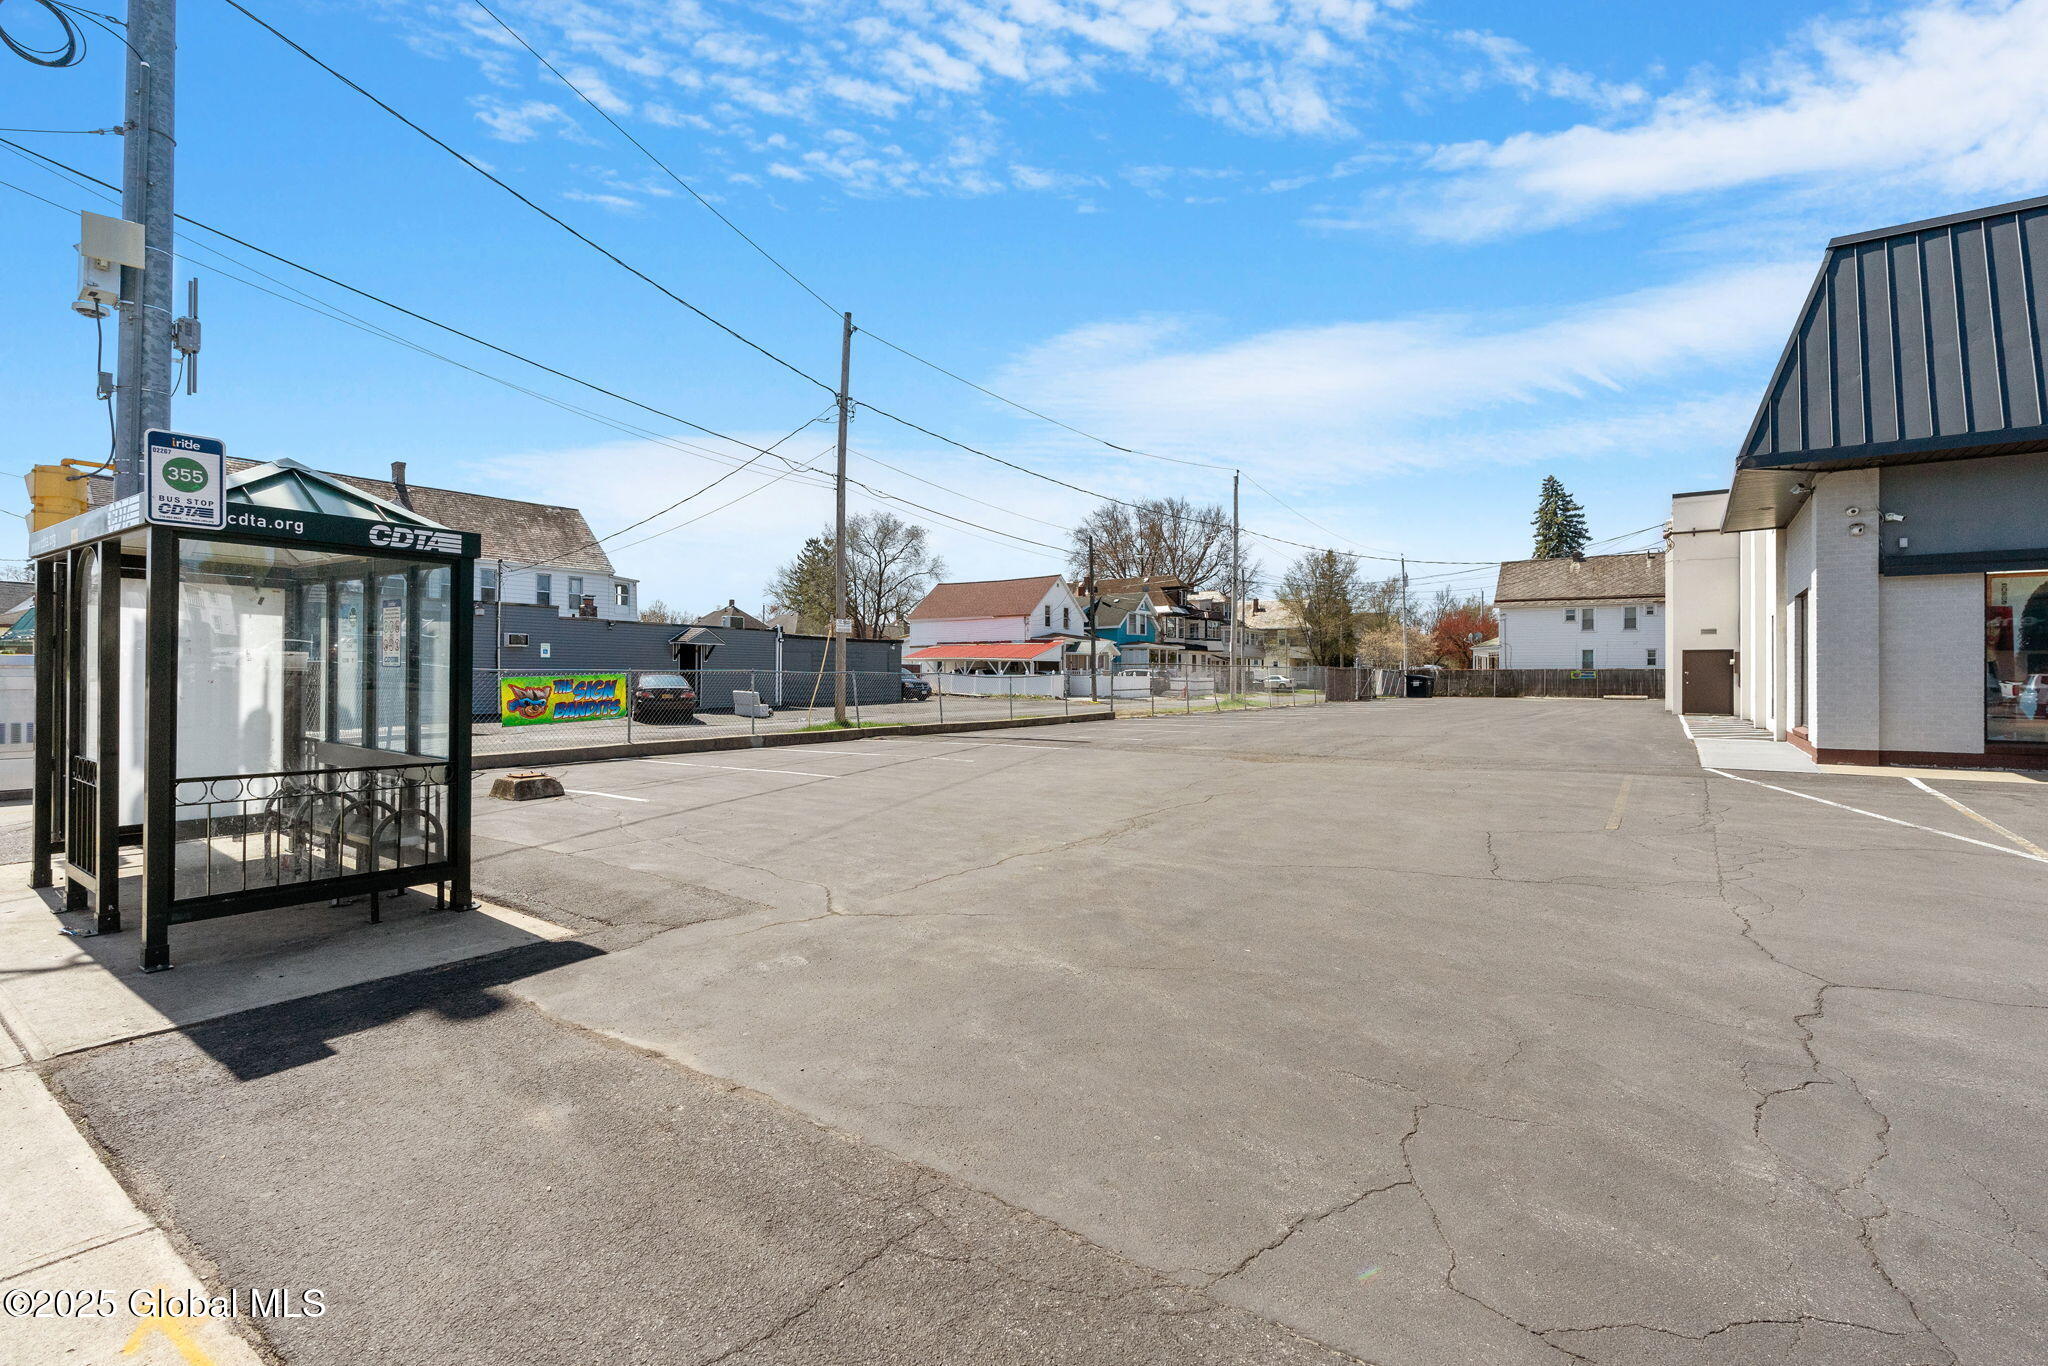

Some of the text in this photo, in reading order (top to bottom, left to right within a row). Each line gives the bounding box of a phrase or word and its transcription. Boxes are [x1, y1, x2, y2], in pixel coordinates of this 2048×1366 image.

[172, 438, 200, 450] iride
[167, 467, 204, 483] 355
[159, 495, 214, 507] BUS STOP
[158, 503, 214, 519] CDTA
[227, 513, 304, 534] cdta.org
[369, 525, 462, 554] CDTA
[552, 679, 618, 701] THE SIGN
[553, 699, 621, 719] BANDITS
